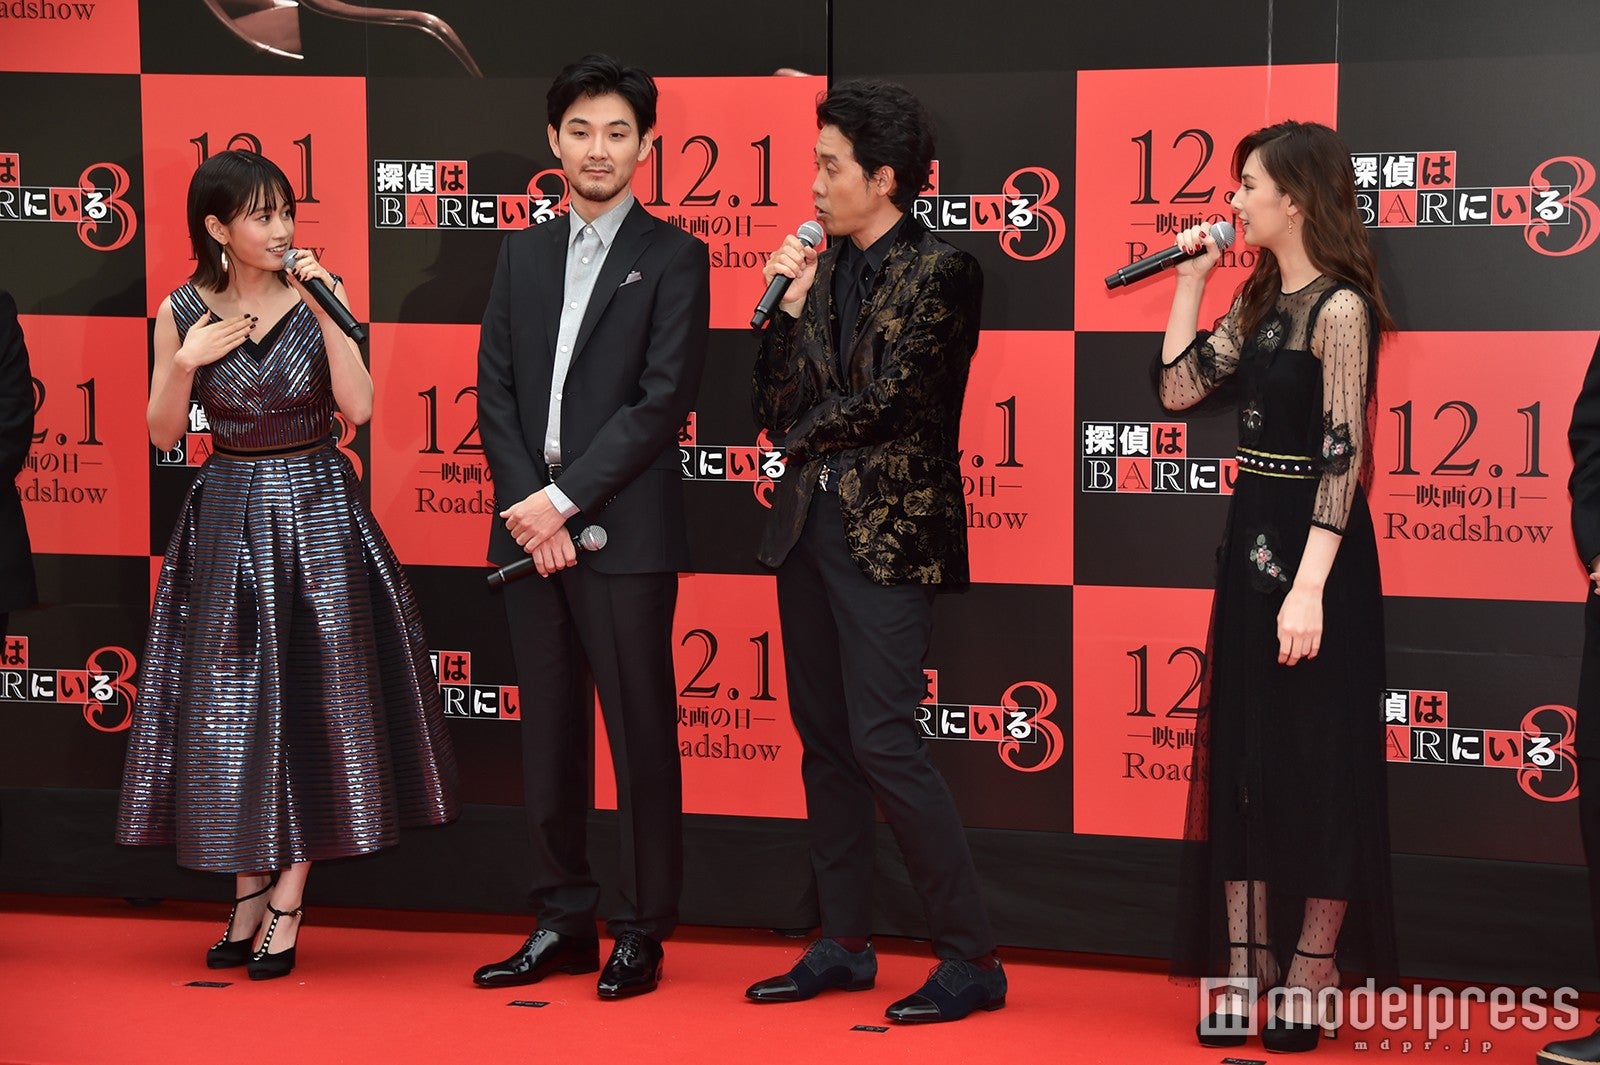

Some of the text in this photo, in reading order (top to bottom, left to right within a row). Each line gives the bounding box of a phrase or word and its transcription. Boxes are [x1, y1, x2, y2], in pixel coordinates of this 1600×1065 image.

[377, 162, 464, 194] 探偵は
[643, 135, 778, 207] 12.1
[1085, 424, 1183, 455] 探偵は
[1388, 400, 1549, 478] 12.1
[1383, 512, 1553, 543] Roadshow
